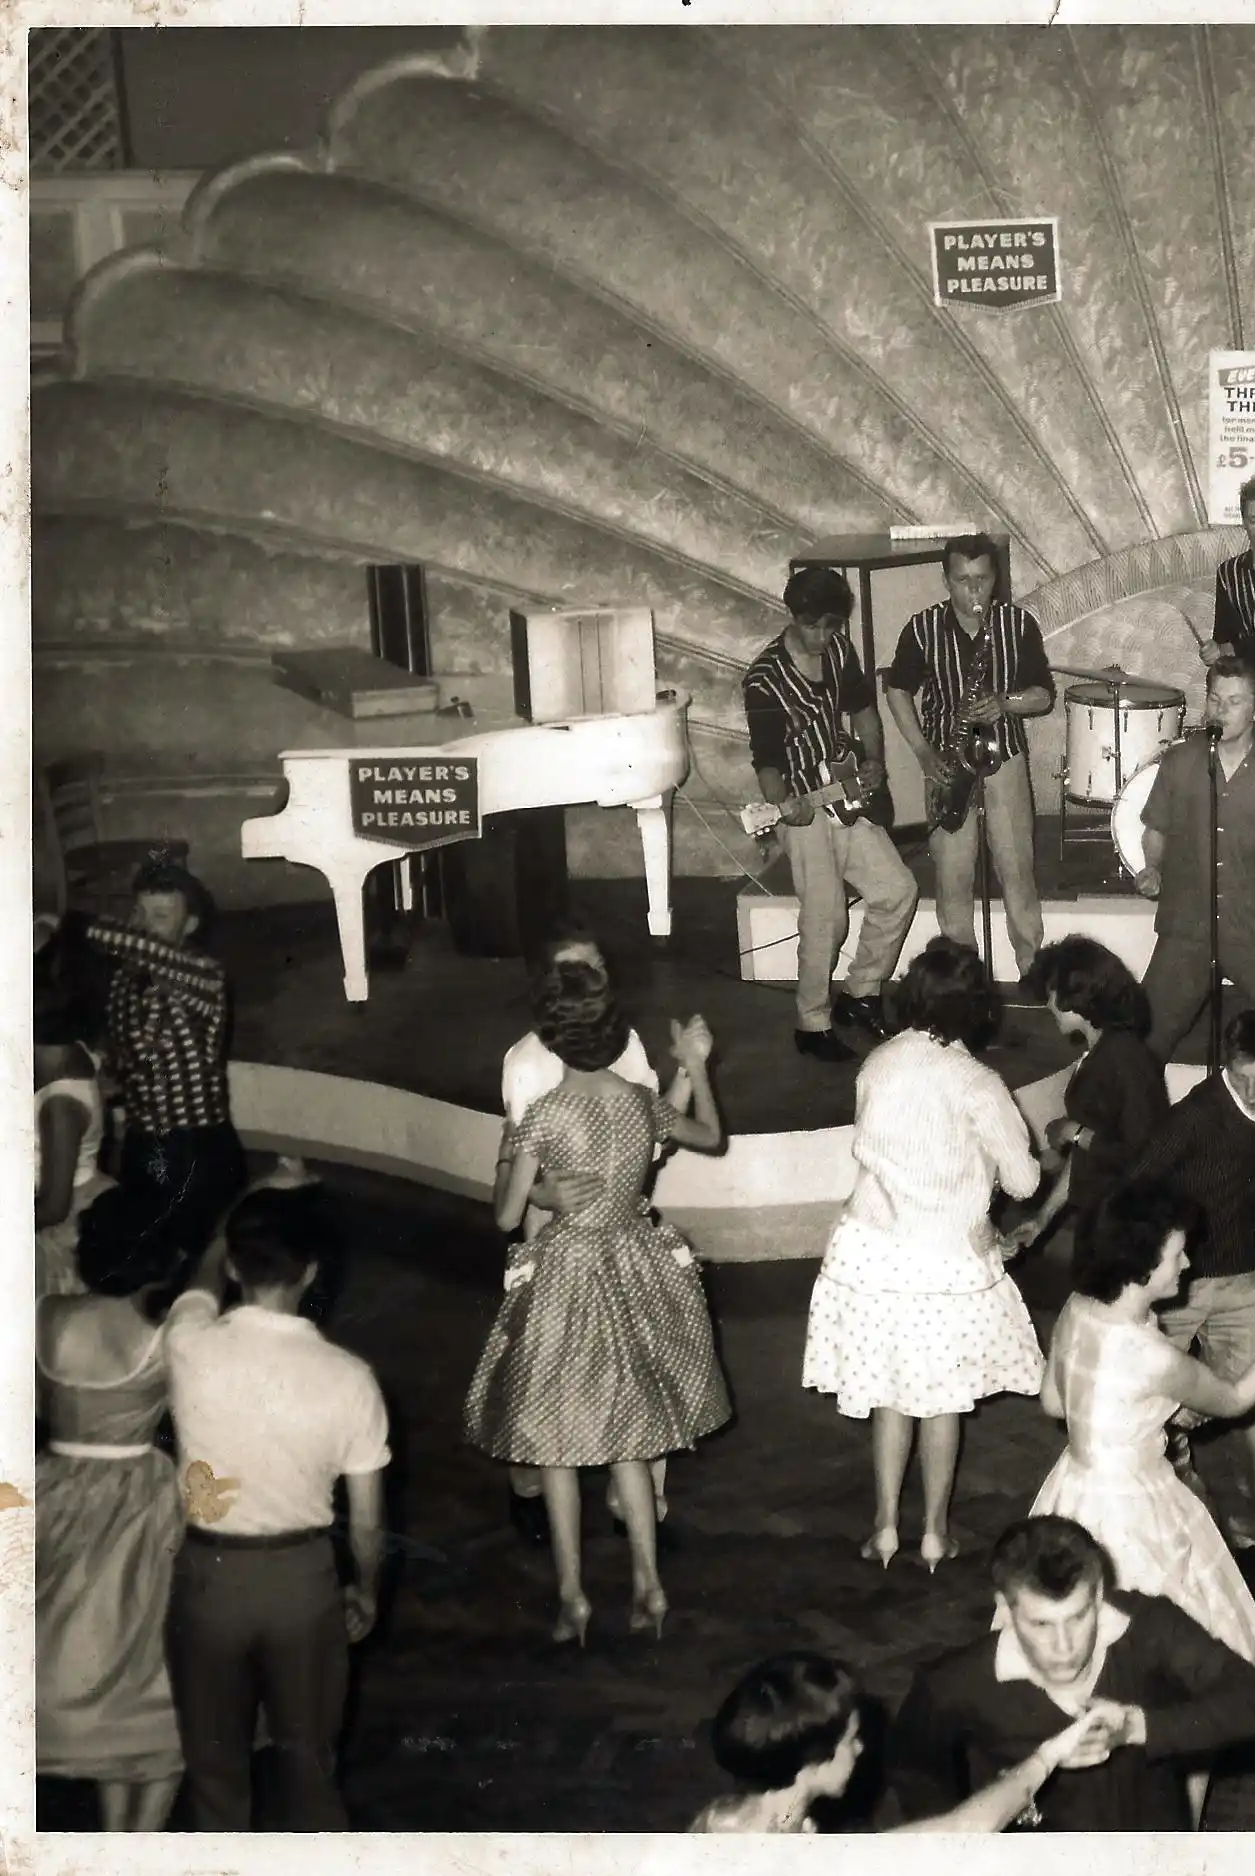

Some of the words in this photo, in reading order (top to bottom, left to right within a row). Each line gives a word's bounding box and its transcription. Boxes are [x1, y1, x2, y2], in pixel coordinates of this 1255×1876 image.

[944, 231, 1046, 250] PLAYER'S
[957, 254, 1035, 271] MEANS
[947, 275, 1048, 293] PLEASURE
[358, 766, 469, 782] PLAYER'S
[373, 788, 457, 804] MEANS
[361, 810, 470, 827] PLEASURE
